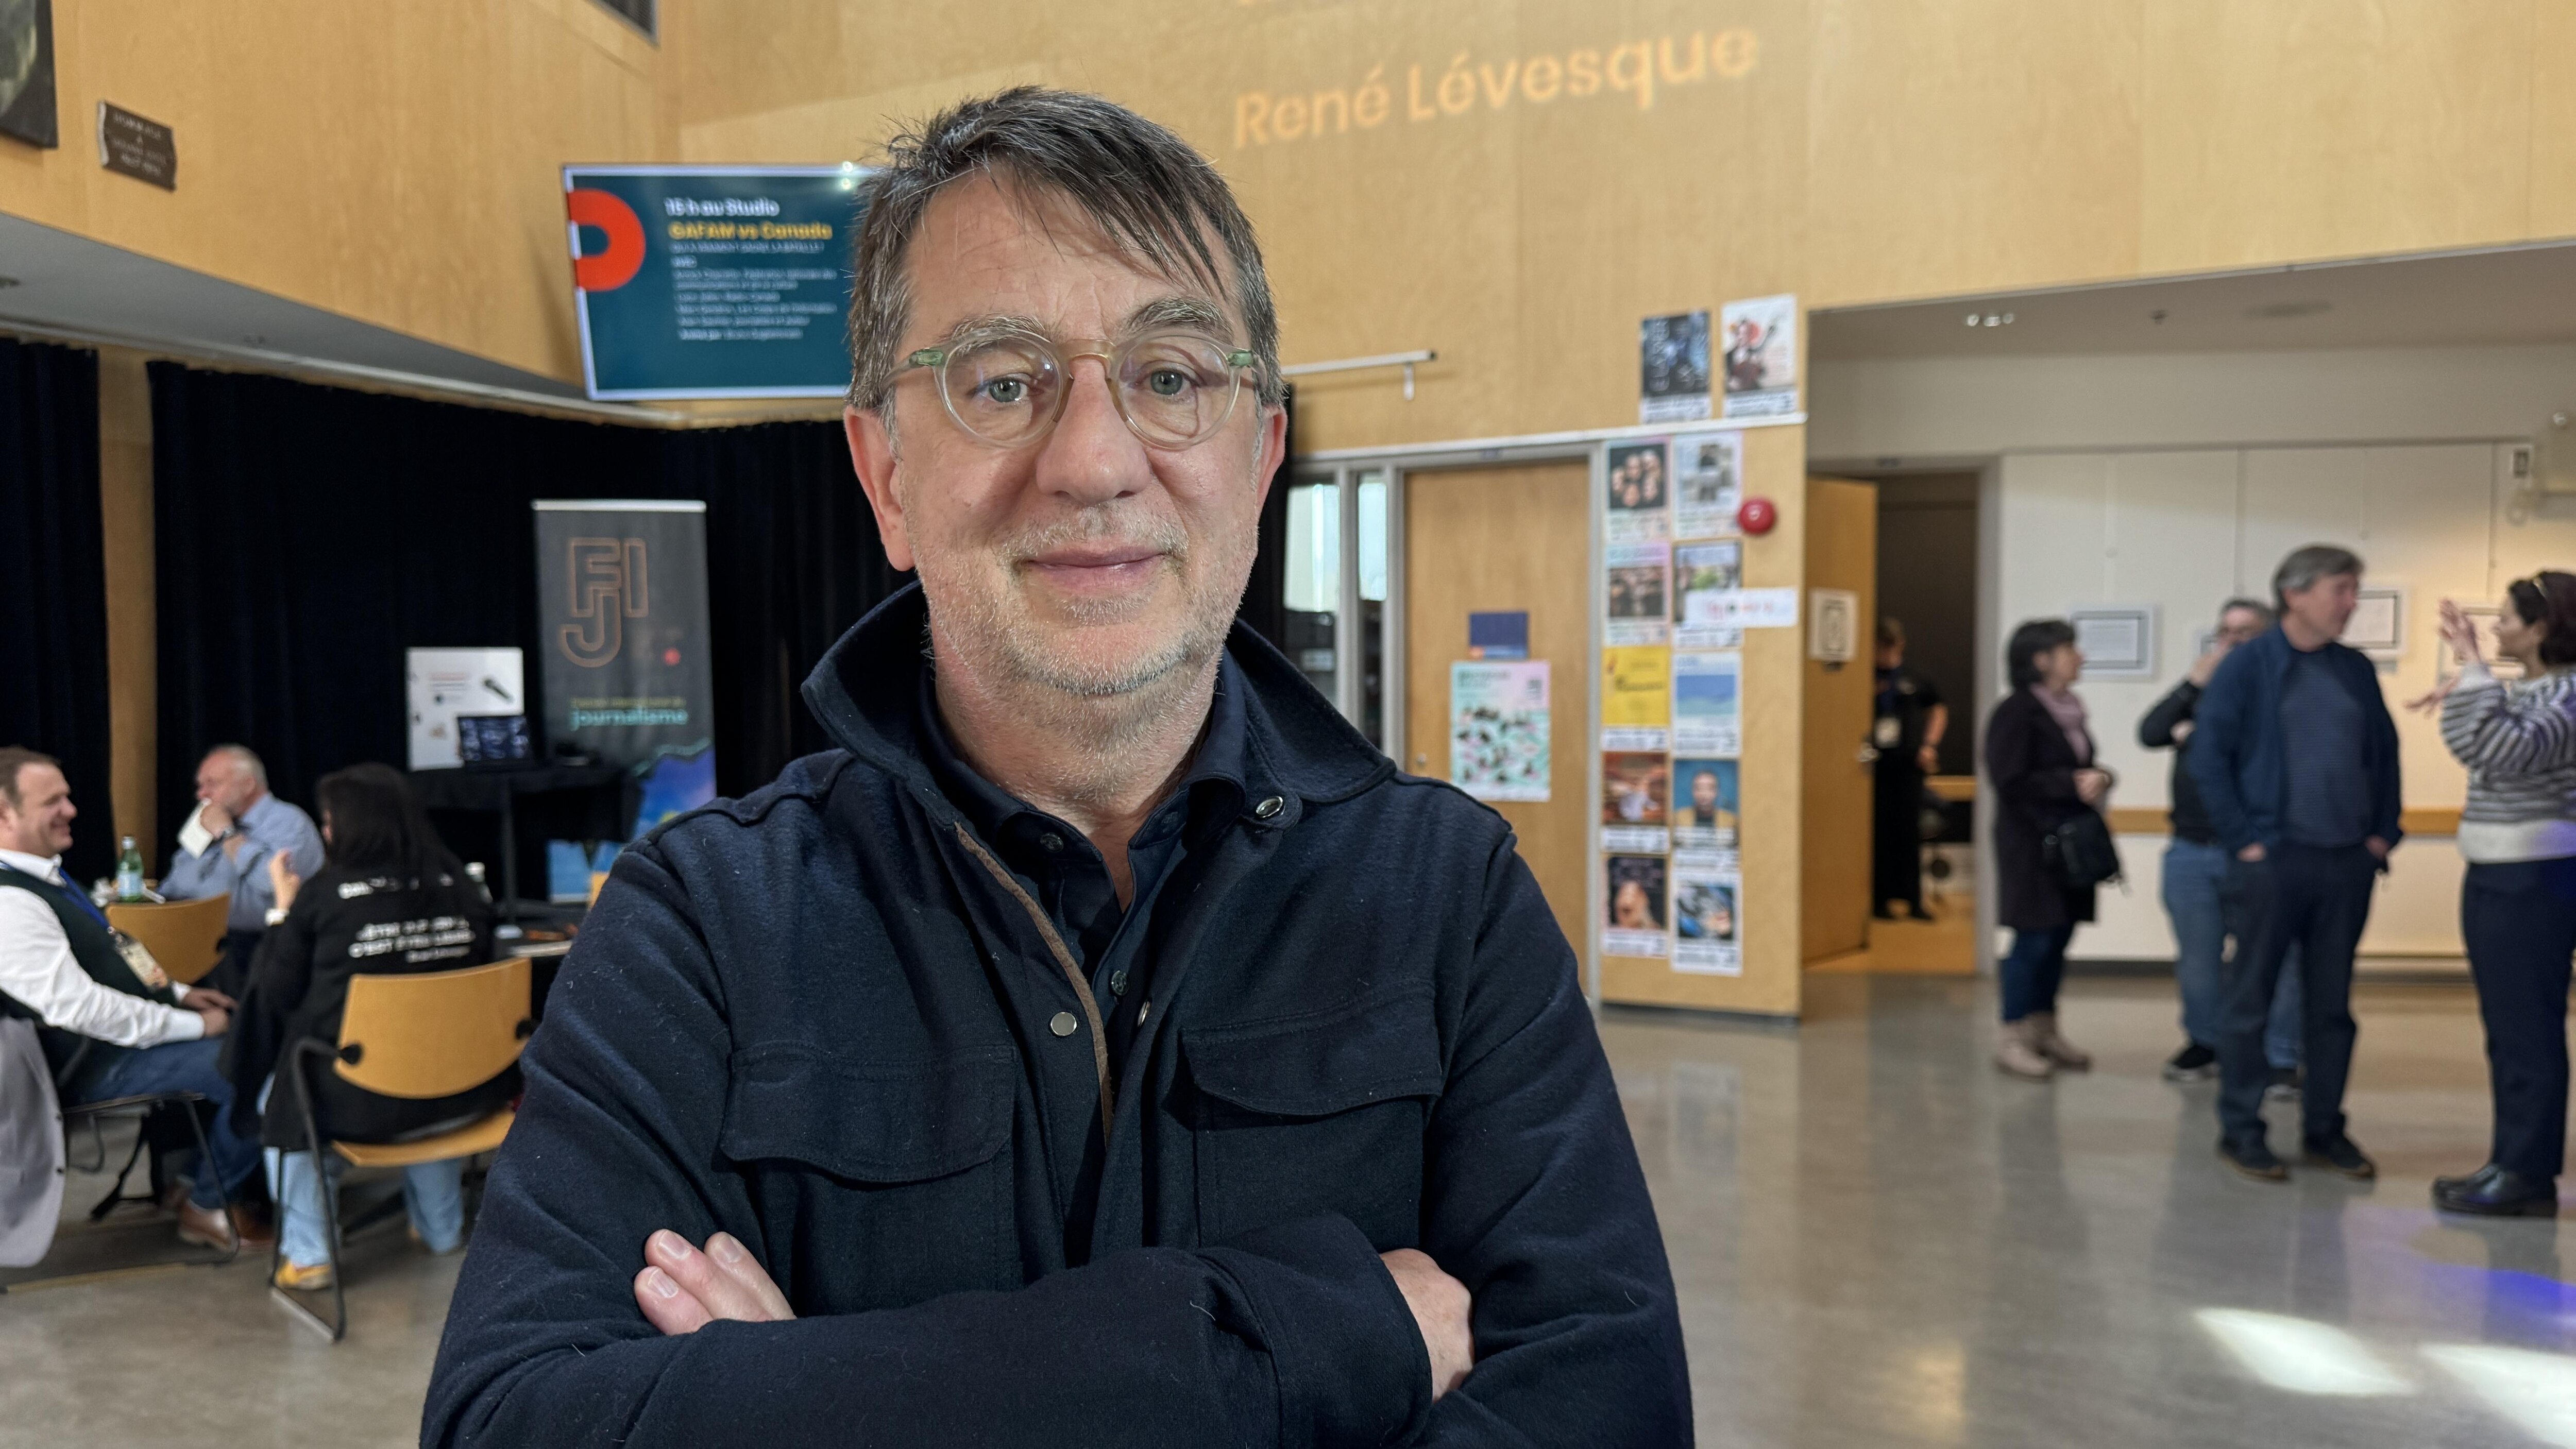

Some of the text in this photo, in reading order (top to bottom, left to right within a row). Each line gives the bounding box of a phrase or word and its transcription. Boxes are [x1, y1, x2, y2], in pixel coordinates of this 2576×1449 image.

[1234, 27, 1759, 148] René Lévesque
[701, 200, 724, 216] au
[725, 198, 779, 216] Studio
[669, 221, 832, 240] GAFAM vs Canada
[570, 708, 687, 731] journalisme
